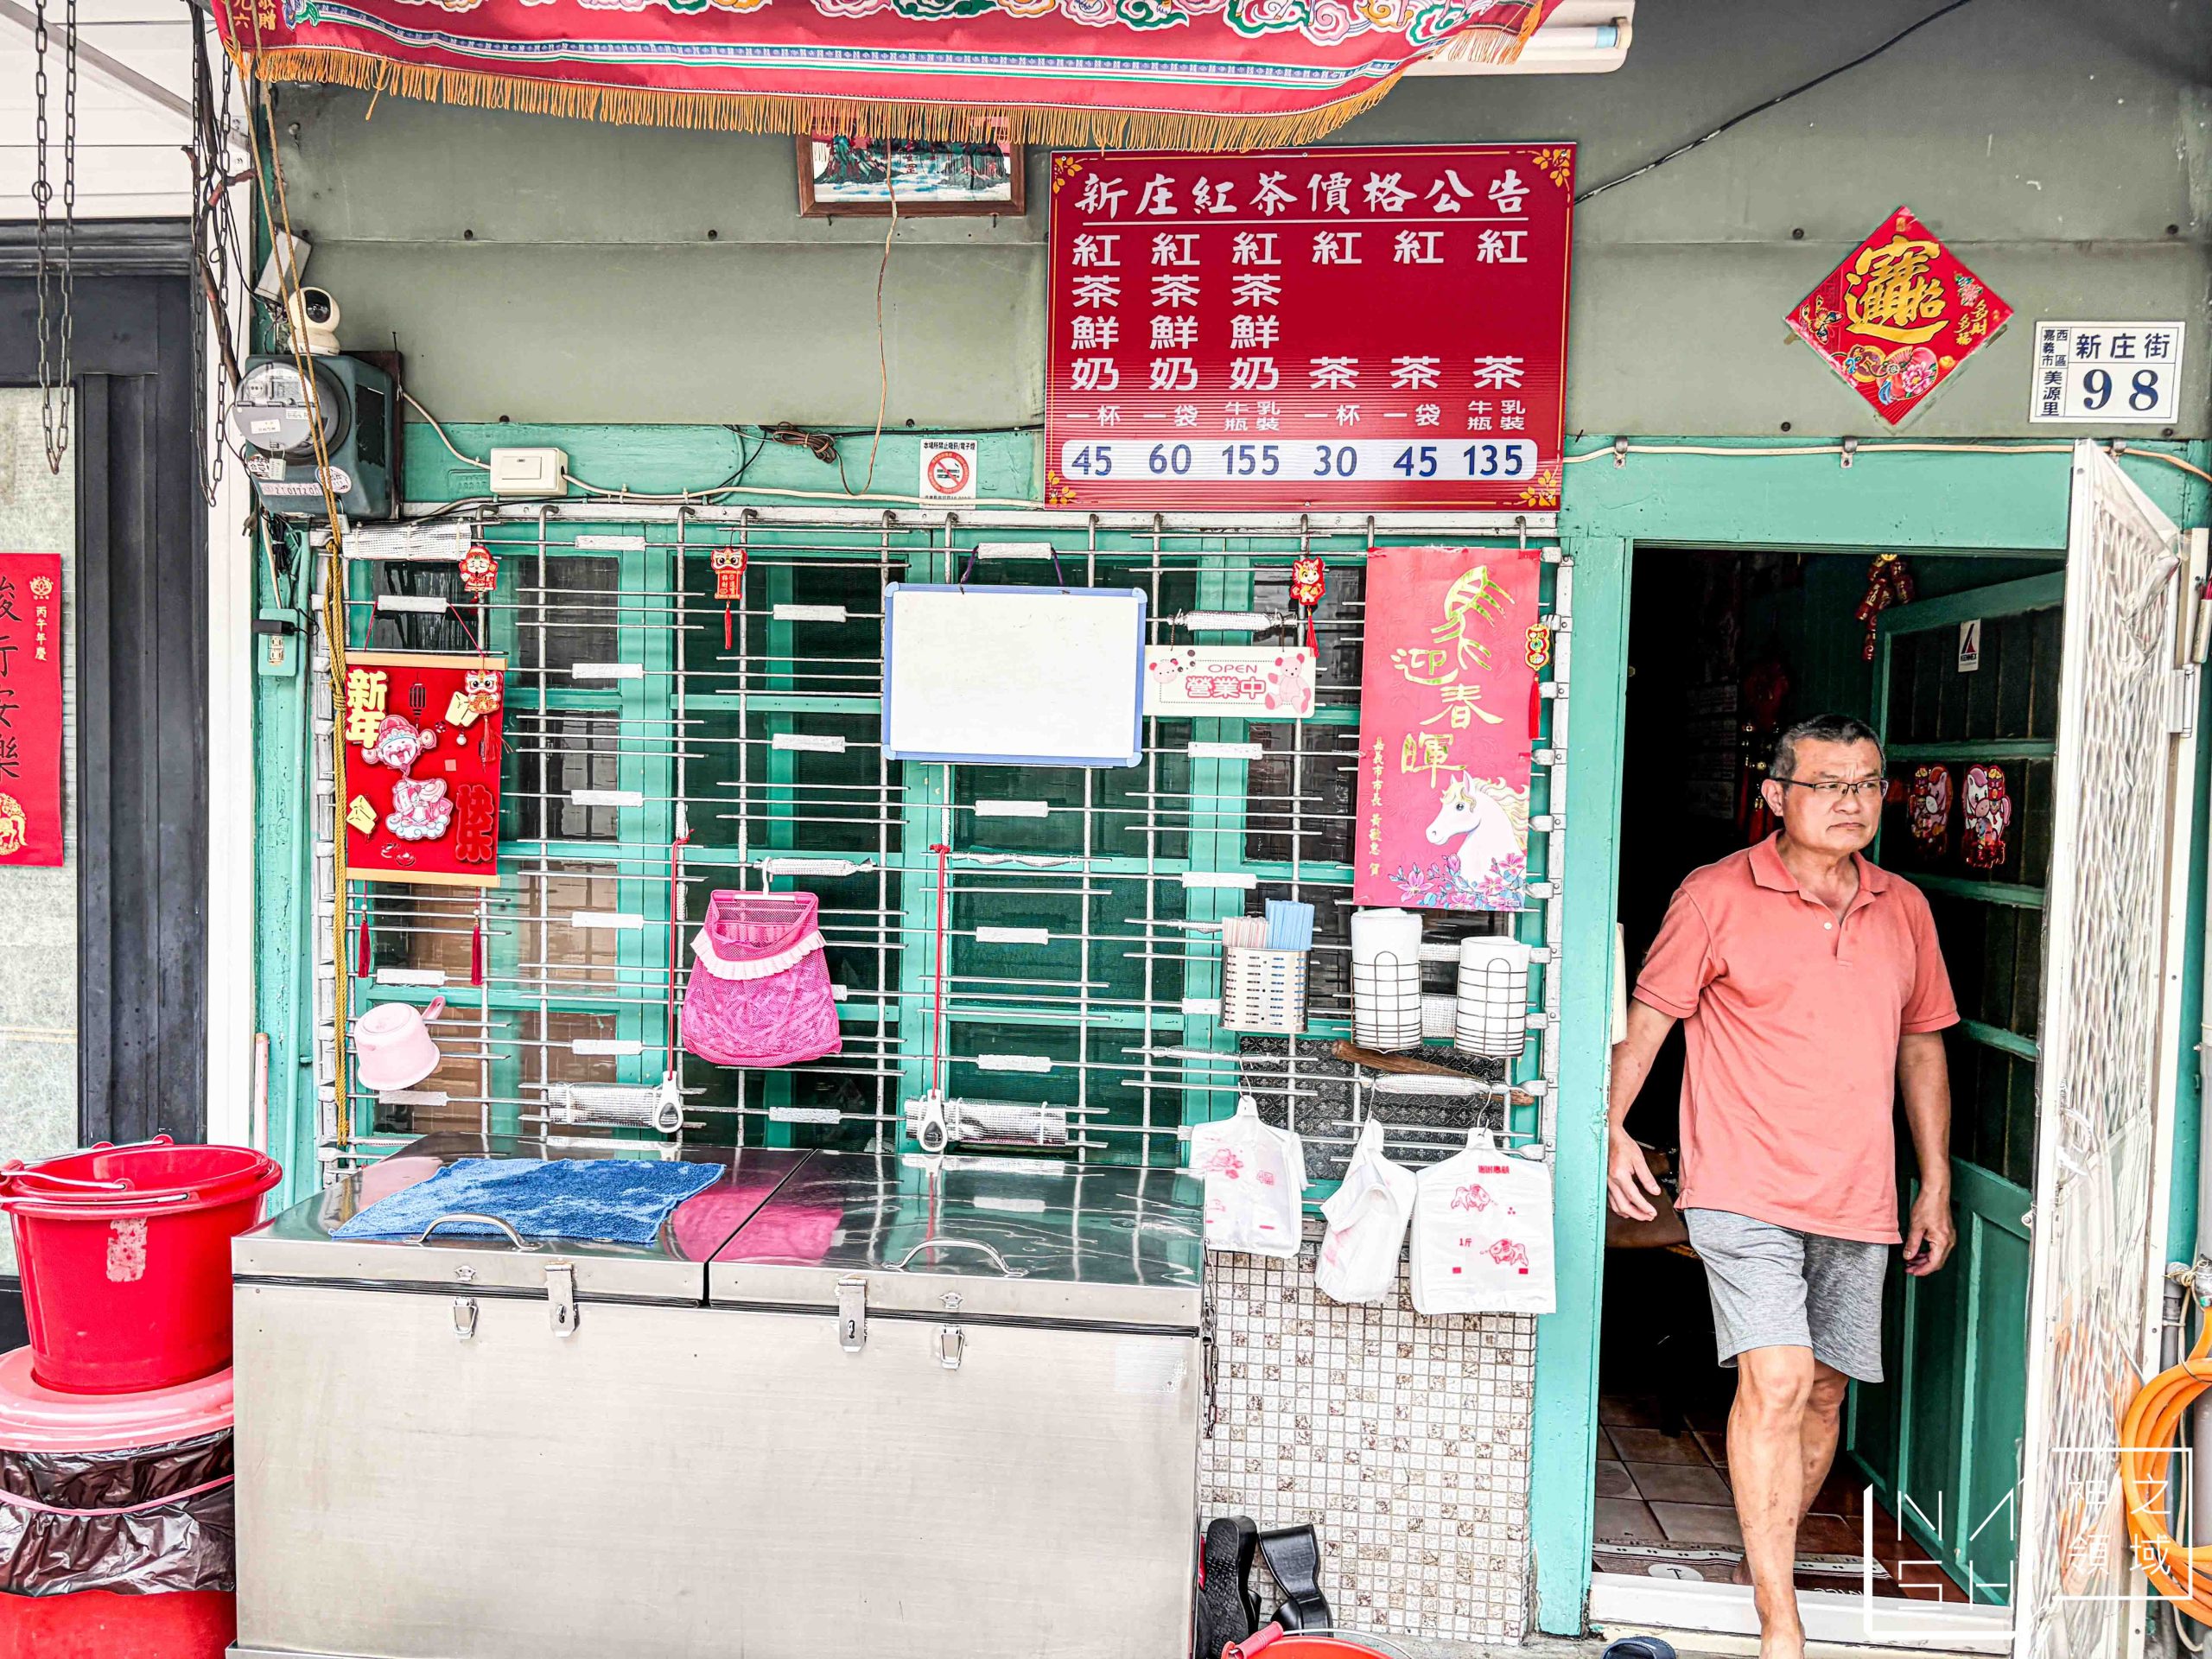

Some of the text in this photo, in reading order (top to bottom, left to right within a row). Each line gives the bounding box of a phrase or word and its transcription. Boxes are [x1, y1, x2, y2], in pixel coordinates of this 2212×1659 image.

[1074, 168, 1531, 219] 新庄紅茶價格公告
[1071, 233, 1122, 392] 紅茶鮮奶
[1149, 232, 1201, 391] 紅茶鮮奶
[1229, 232, 1282, 391] 紅茶鮮奶
[2042, 329, 2056, 366] 嘉義市
[2055, 329, 2069, 366] 西區
[2075, 333, 2171, 359] 新庄街
[2040, 370, 2063, 416] 美源里
[2082, 368, 2159, 411] 98
[1066, 404, 1122, 428] 一杯
[1142, 404, 1199, 429] 一袋
[1304, 404, 1362, 428] 一杯
[1383, 403, 1441, 428] 一袋
[1071, 445, 1113, 476] 45
[1149, 444, 1192, 476] 60
[1221, 445, 1281, 476] 155
[1313, 445, 1358, 477] 30
[1393, 445, 1439, 477] 45
[1462, 444, 1524, 477] 135
[1208, 664, 1257, 674] OPEN
[1185, 675, 1267, 700] 營業中
[346, 669, 388, 749] 新年
